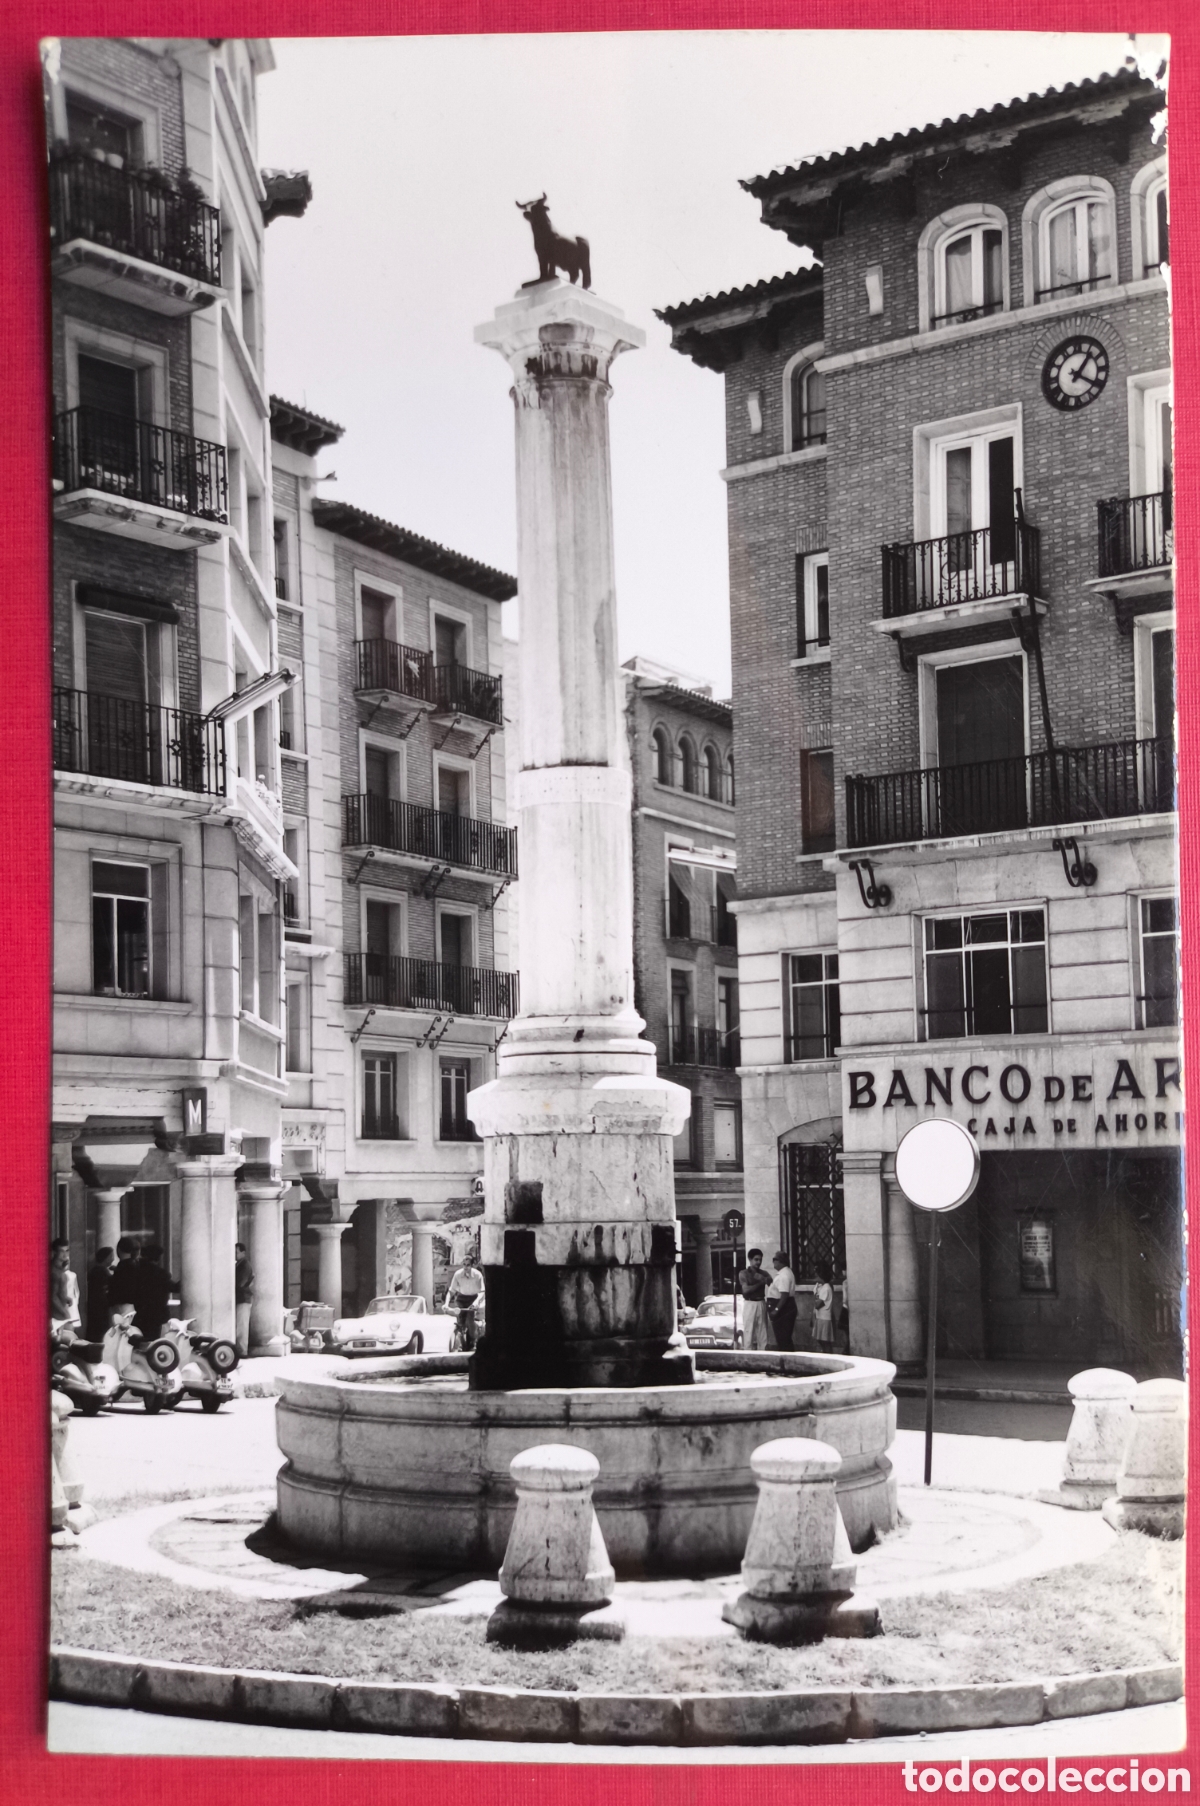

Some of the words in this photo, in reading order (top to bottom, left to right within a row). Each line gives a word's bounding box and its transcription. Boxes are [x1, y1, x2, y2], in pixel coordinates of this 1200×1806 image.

[848, 1064, 1031, 1109] BANCO
[1044, 1076, 1092, 1102] DE
[188, 1099, 202, 1125] M
[967, 1116, 1036, 1138] CAJA
[1053, 1119, 1076, 1133] DE
